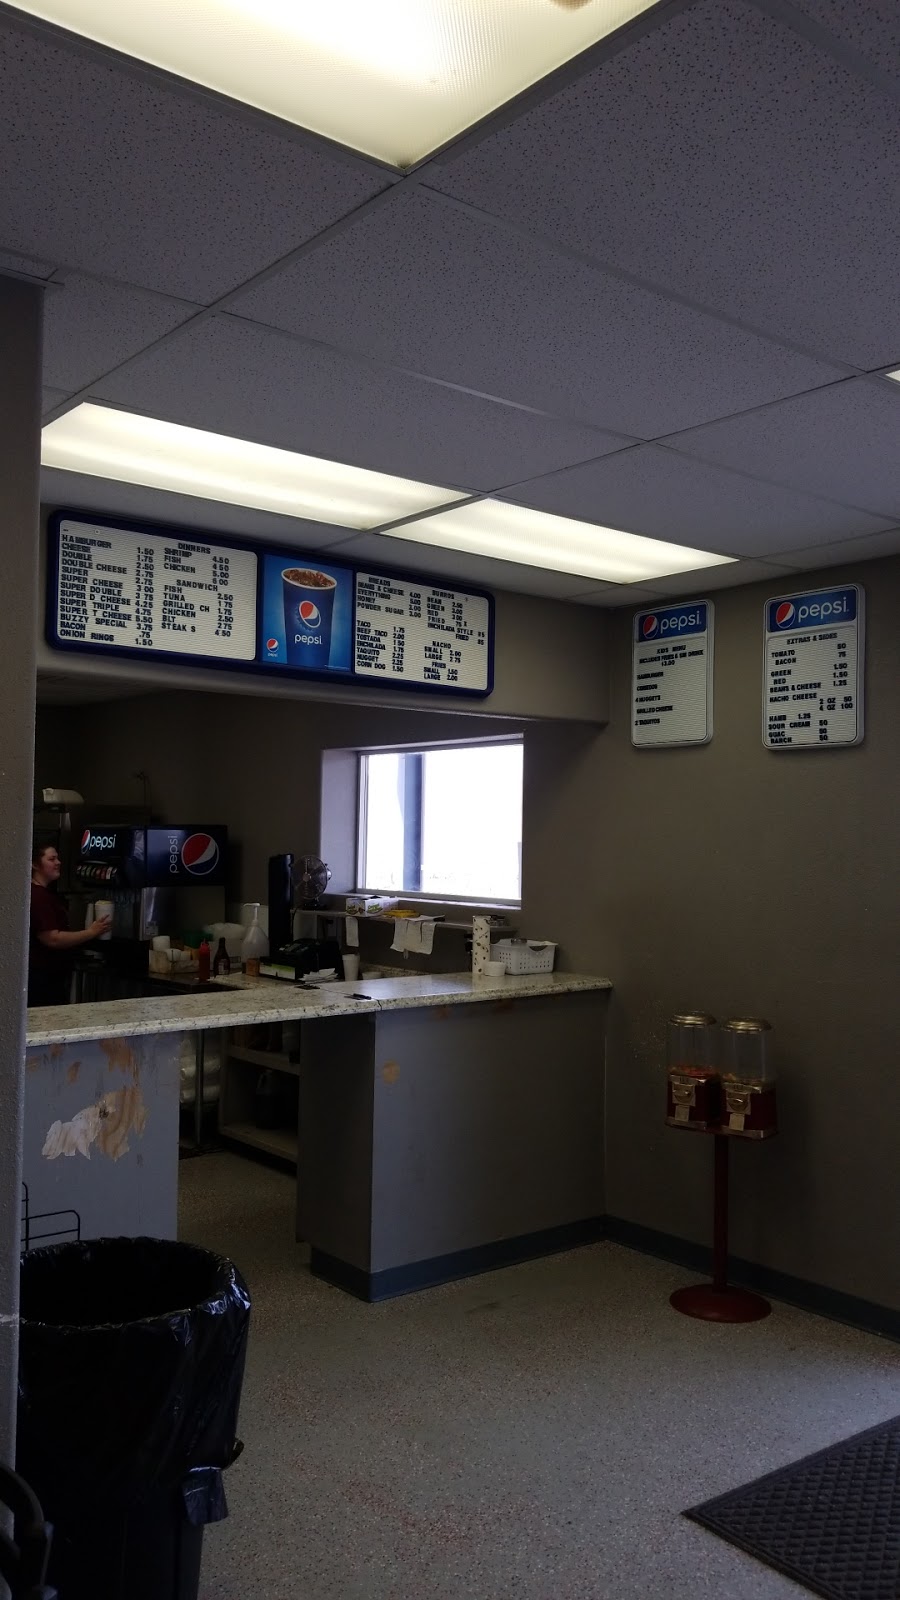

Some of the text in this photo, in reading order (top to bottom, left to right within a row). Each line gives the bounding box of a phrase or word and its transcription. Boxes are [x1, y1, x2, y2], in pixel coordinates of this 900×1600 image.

[62, 535, 111, 548] HAMBURGER
[62, 544, 90, 552] CHEESE
[178, 543, 210, 554] DINNERS
[62, 551, 92, 560] DOUBLE
[164, 548, 229, 564] SHRIMP 4.50
[62, 559, 153, 578] DOUBLE CHEESE 2.75
[62, 567, 88, 576] SUPER
[164, 563, 195, 573] CHICKEN
[62, 574, 123, 588] SUPER CHEESE
[177, 580, 218, 591] SANDWICH
[61, 582, 121, 596] SUPER DOUBLE
[165, 585, 182, 593] FISH
[61, 590, 85, 599] SUPER
[101, 596, 131, 605] CHEESE
[164, 593, 185, 601] TUNA
[60, 598, 86, 607] SUPER
[93, 602, 119, 611] TRIPLE
[163, 601, 194, 610] GRILLED
[798, 597, 847, 622] pepsi
[60, 606, 87, 614] SUPER
[103, 612, 132, 621] CHEESE
[163, 608, 195, 617] CHICKEN
[60, 622, 85, 630] BACON
[61, 614, 89, 622] BUZZY
[96, 618, 127, 627] SPECIAL
[660, 611, 700, 633] pepsi
[162, 623, 186, 631] STEAK
[60, 630, 85, 638] ONION
[91, 633, 114, 641] RINGS
[295, 634, 322, 645] pepsi
[433, 641, 451, 649] NACHO
[797, 682, 821, 690] CHEESE
[89, 834, 116, 850] pepsi
[168, 835, 179, 873] pepsi
